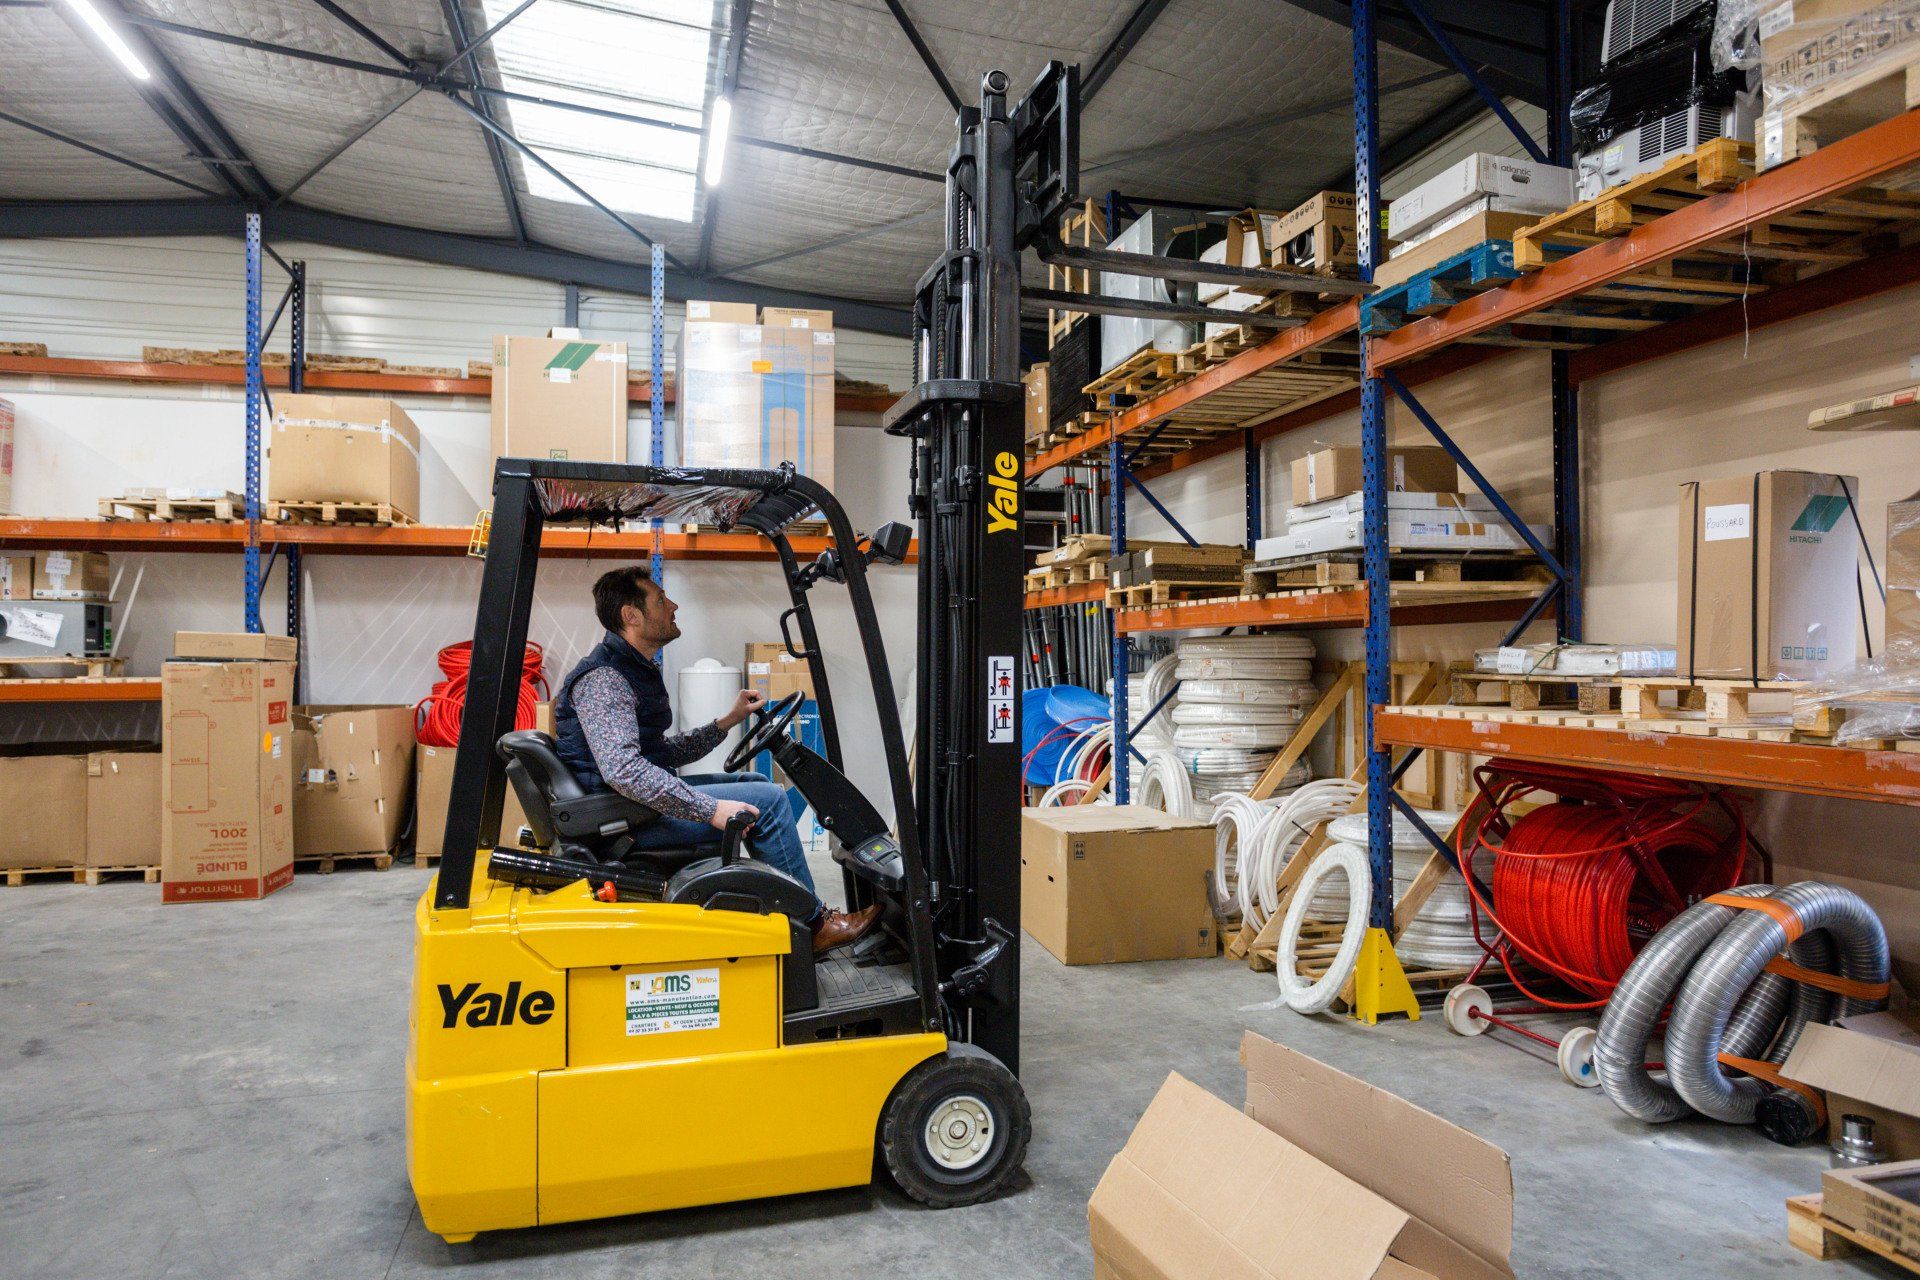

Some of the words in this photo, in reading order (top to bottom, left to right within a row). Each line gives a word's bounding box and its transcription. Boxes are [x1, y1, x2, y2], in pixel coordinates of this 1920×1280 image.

[1500, 164, 1532, 176] atlantic
[987, 451, 1019, 534] Yale
[1789, 535, 1822, 544] HITACHI
[210, 829, 218, 838] L
[220, 828, 248, 838] 200
[196, 861, 248, 876] BLINDÉ
[188, 884, 244, 895] Thermor
[436, 980, 556, 1029] Yale
[629, 994, 717, 1005] www.ams-manutention.com
[663, 1020, 671, 1029] &
